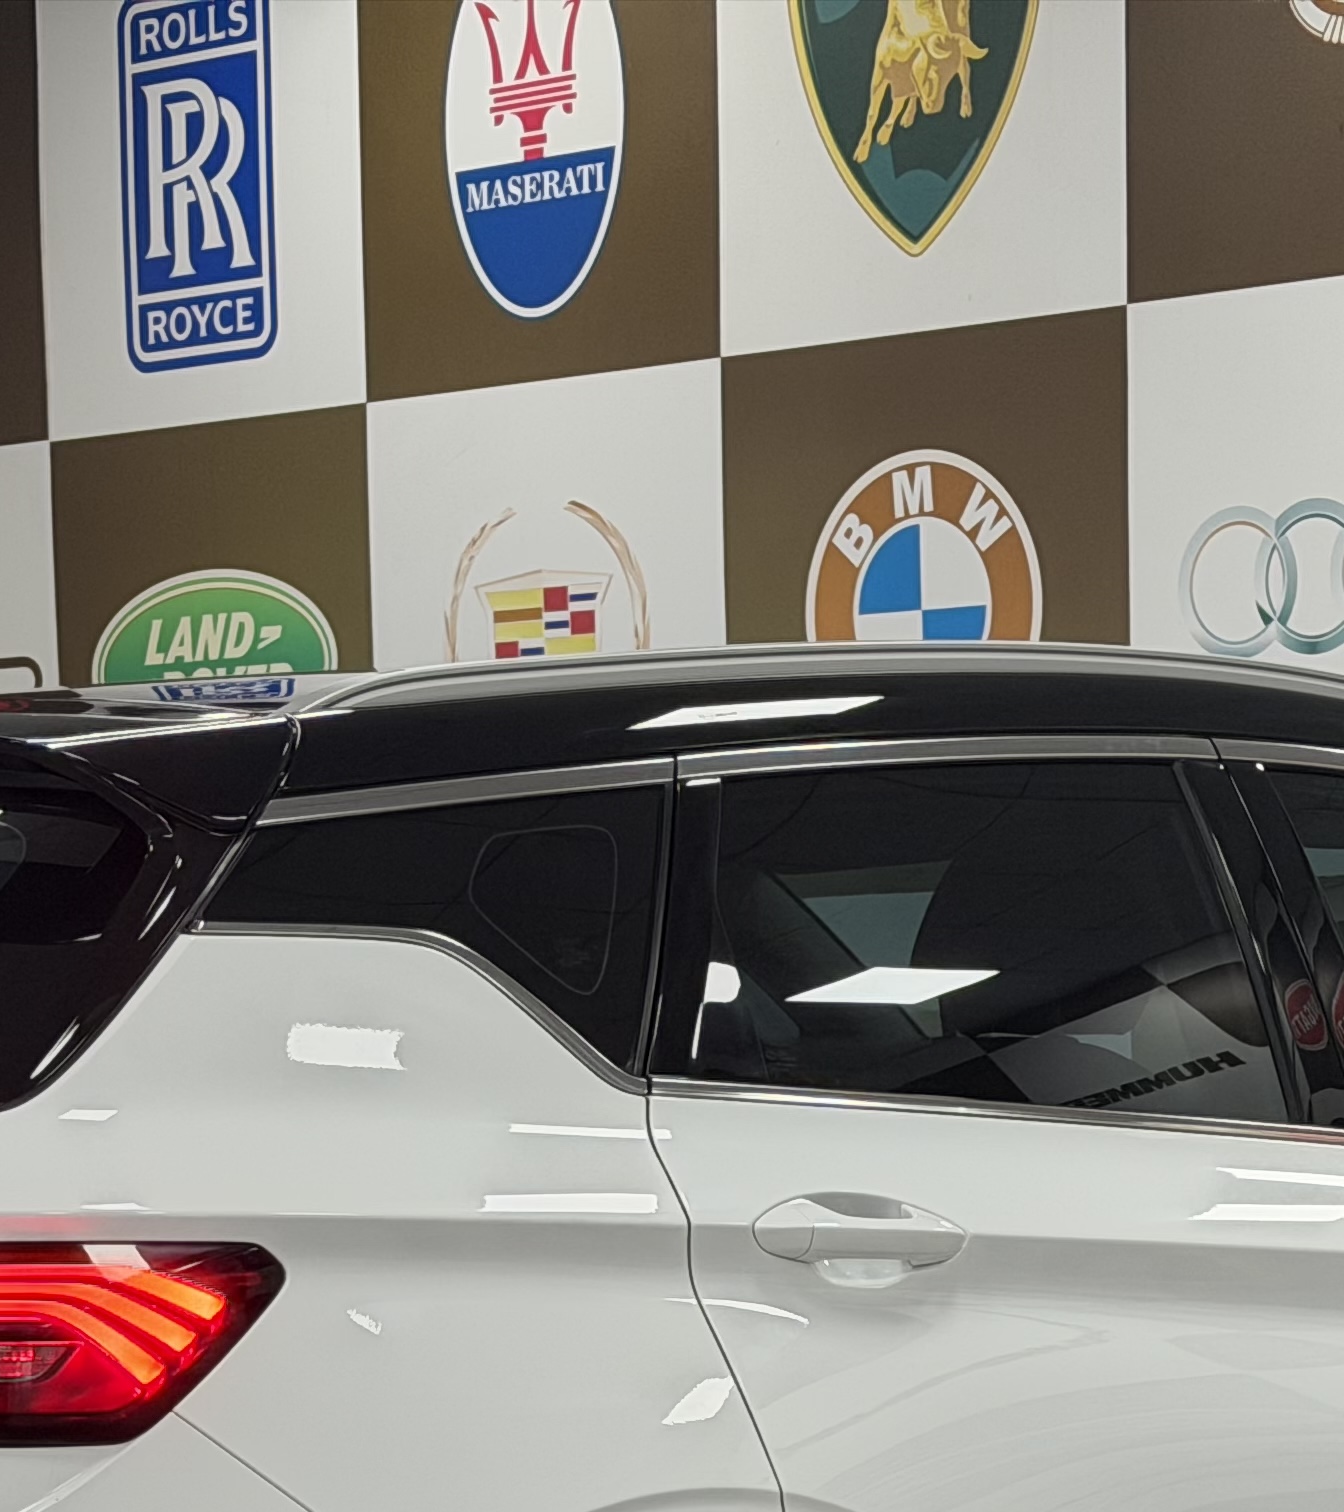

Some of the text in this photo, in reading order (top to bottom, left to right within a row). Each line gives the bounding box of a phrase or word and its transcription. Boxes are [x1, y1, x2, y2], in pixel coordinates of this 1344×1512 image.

[139, 1, 248, 56] ROLLS
[465, 162, 606, 215] MASERATI
[145, 296, 256, 346] ROYCE
[832, 465, 1012, 567] BMW
